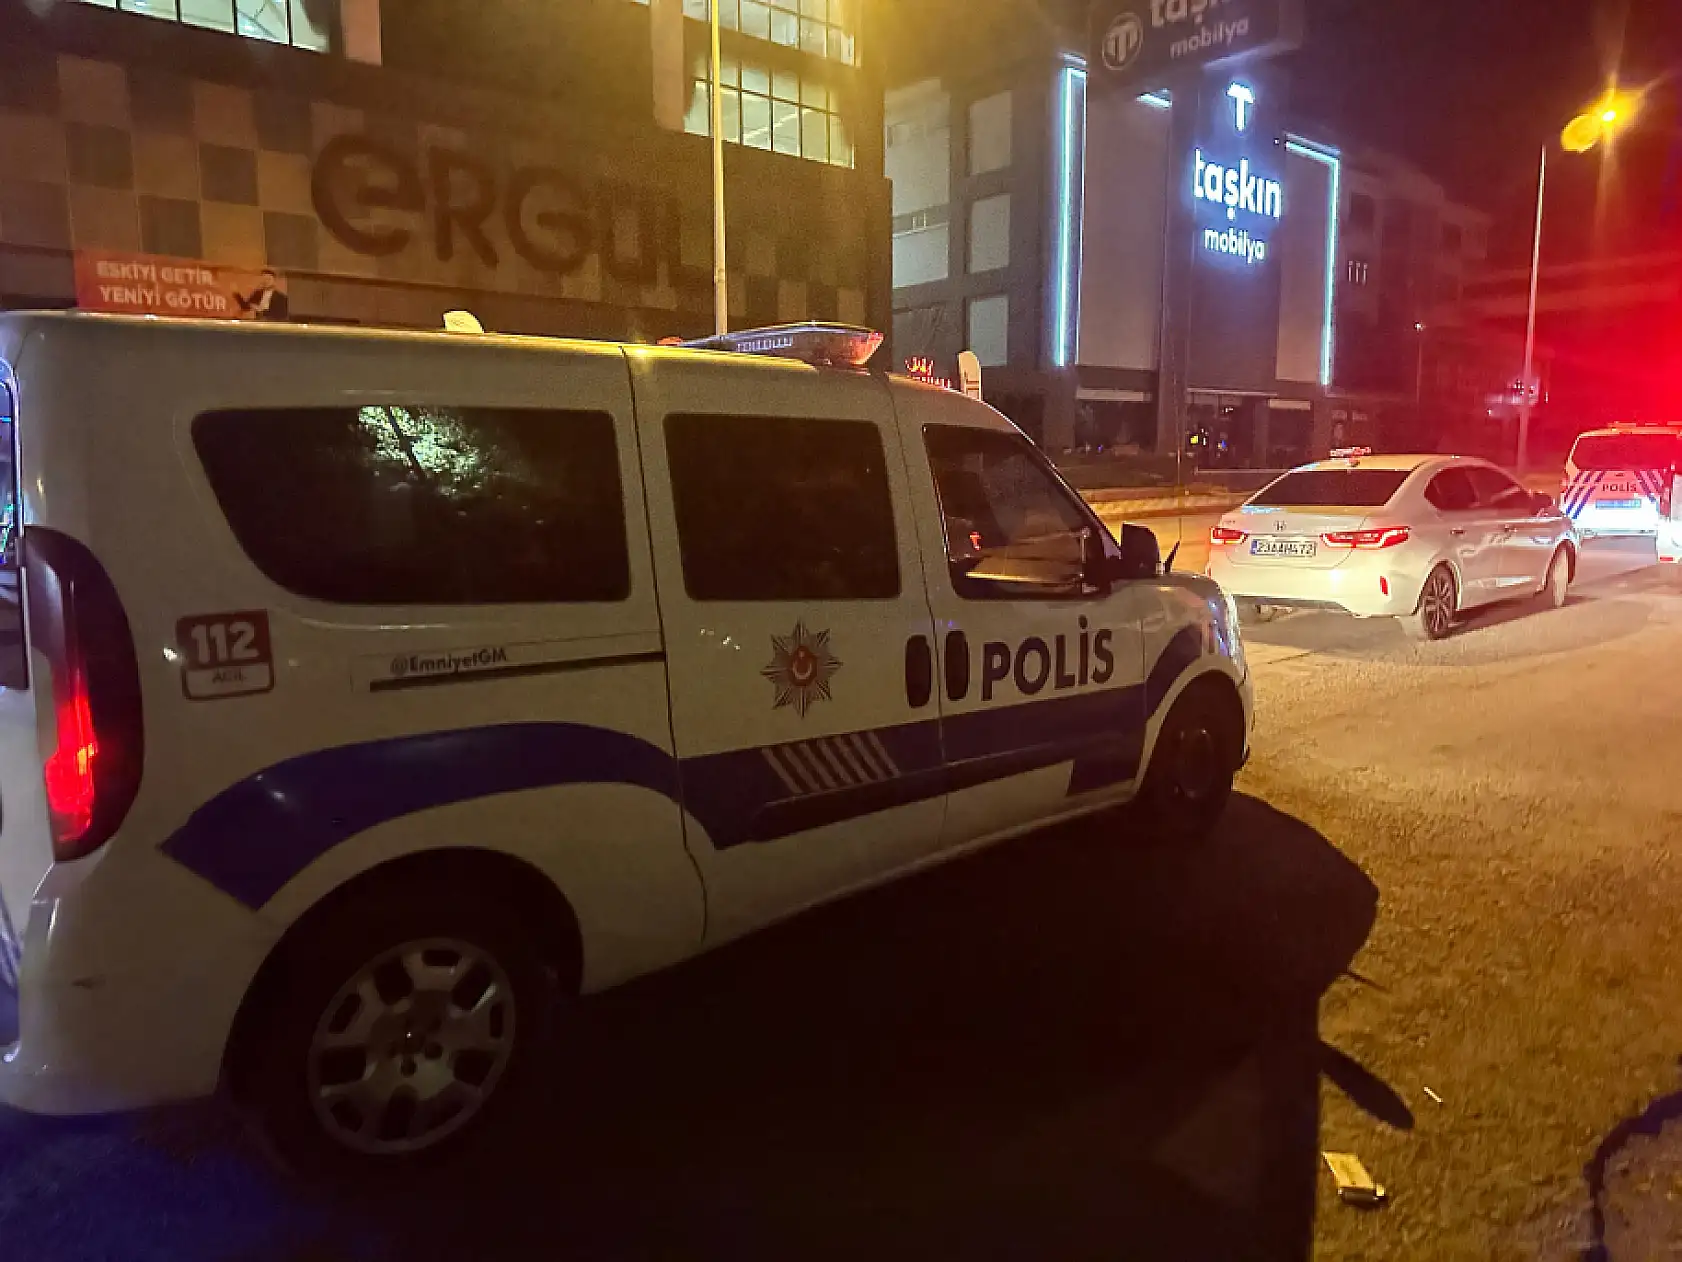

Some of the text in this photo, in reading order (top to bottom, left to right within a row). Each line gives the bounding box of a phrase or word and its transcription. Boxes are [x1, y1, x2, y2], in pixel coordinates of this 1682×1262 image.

[1170, 17, 1249, 60] mobilya
[1194, 148, 1281, 220] taşkın
[1204, 227, 1265, 264] mobilya
[187, 620, 260, 663] 112
[980, 614, 1114, 701] POLİS
